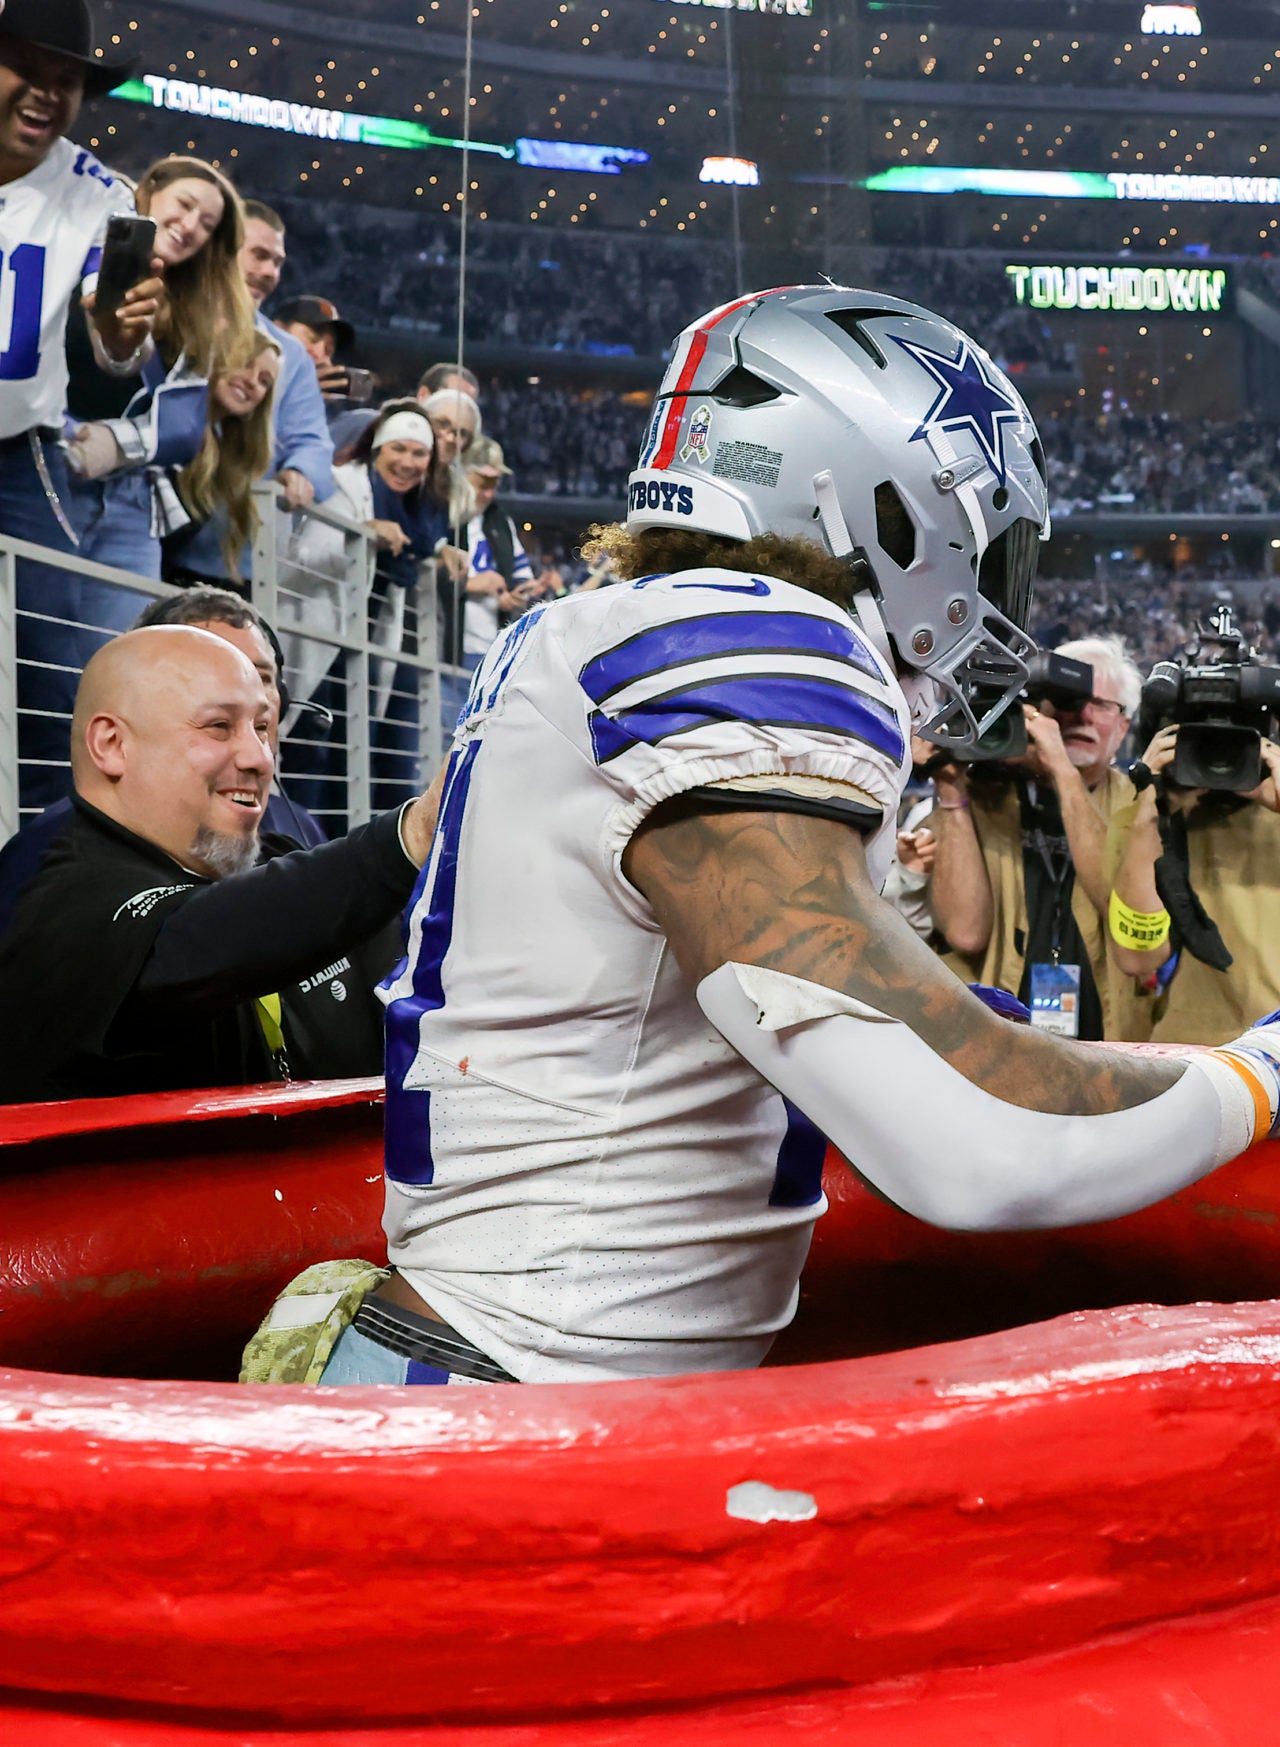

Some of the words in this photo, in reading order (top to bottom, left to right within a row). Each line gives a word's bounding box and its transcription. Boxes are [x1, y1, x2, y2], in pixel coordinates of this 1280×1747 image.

[143, 74, 345, 140] TOUCHDOWN
[1108, 173, 1280, 204] TOUCHDOWN
[1005, 265, 1227, 312] TOUCHDOWN
[734, 440, 768, 450] WARNING
